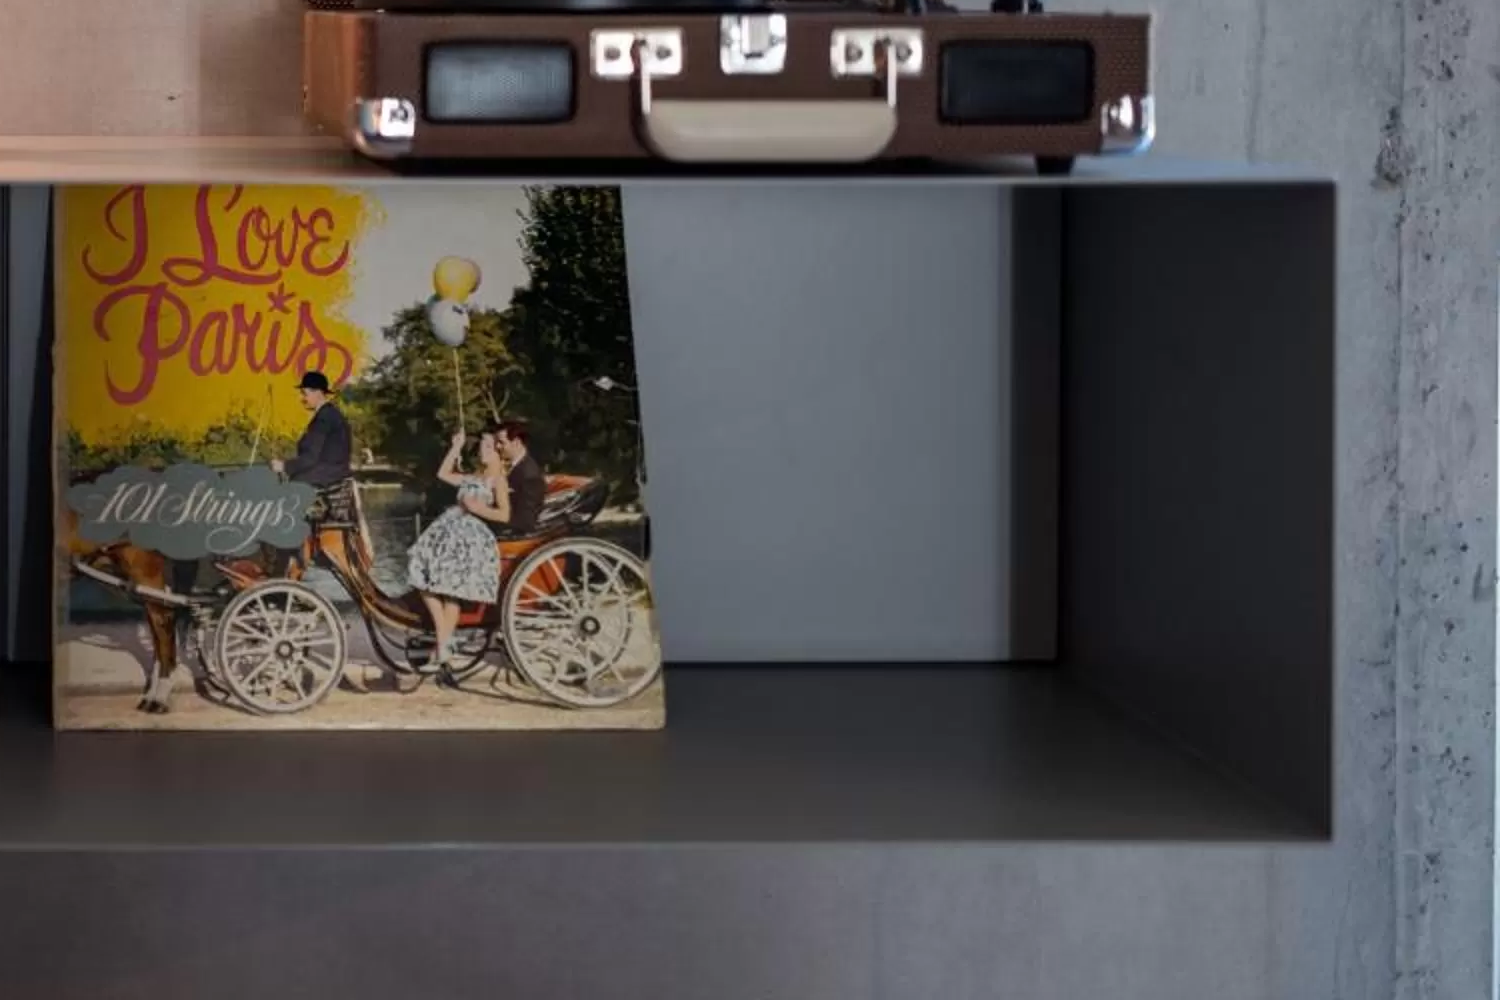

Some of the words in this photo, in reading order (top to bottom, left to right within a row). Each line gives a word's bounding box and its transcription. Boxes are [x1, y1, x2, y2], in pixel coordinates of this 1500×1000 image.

[81, 183, 149, 285] I
[160, 183, 350, 287] Love
[93, 282, 353, 407] Paris
[92, 482, 167, 524] 101
[157, 478, 301, 555] Strings
